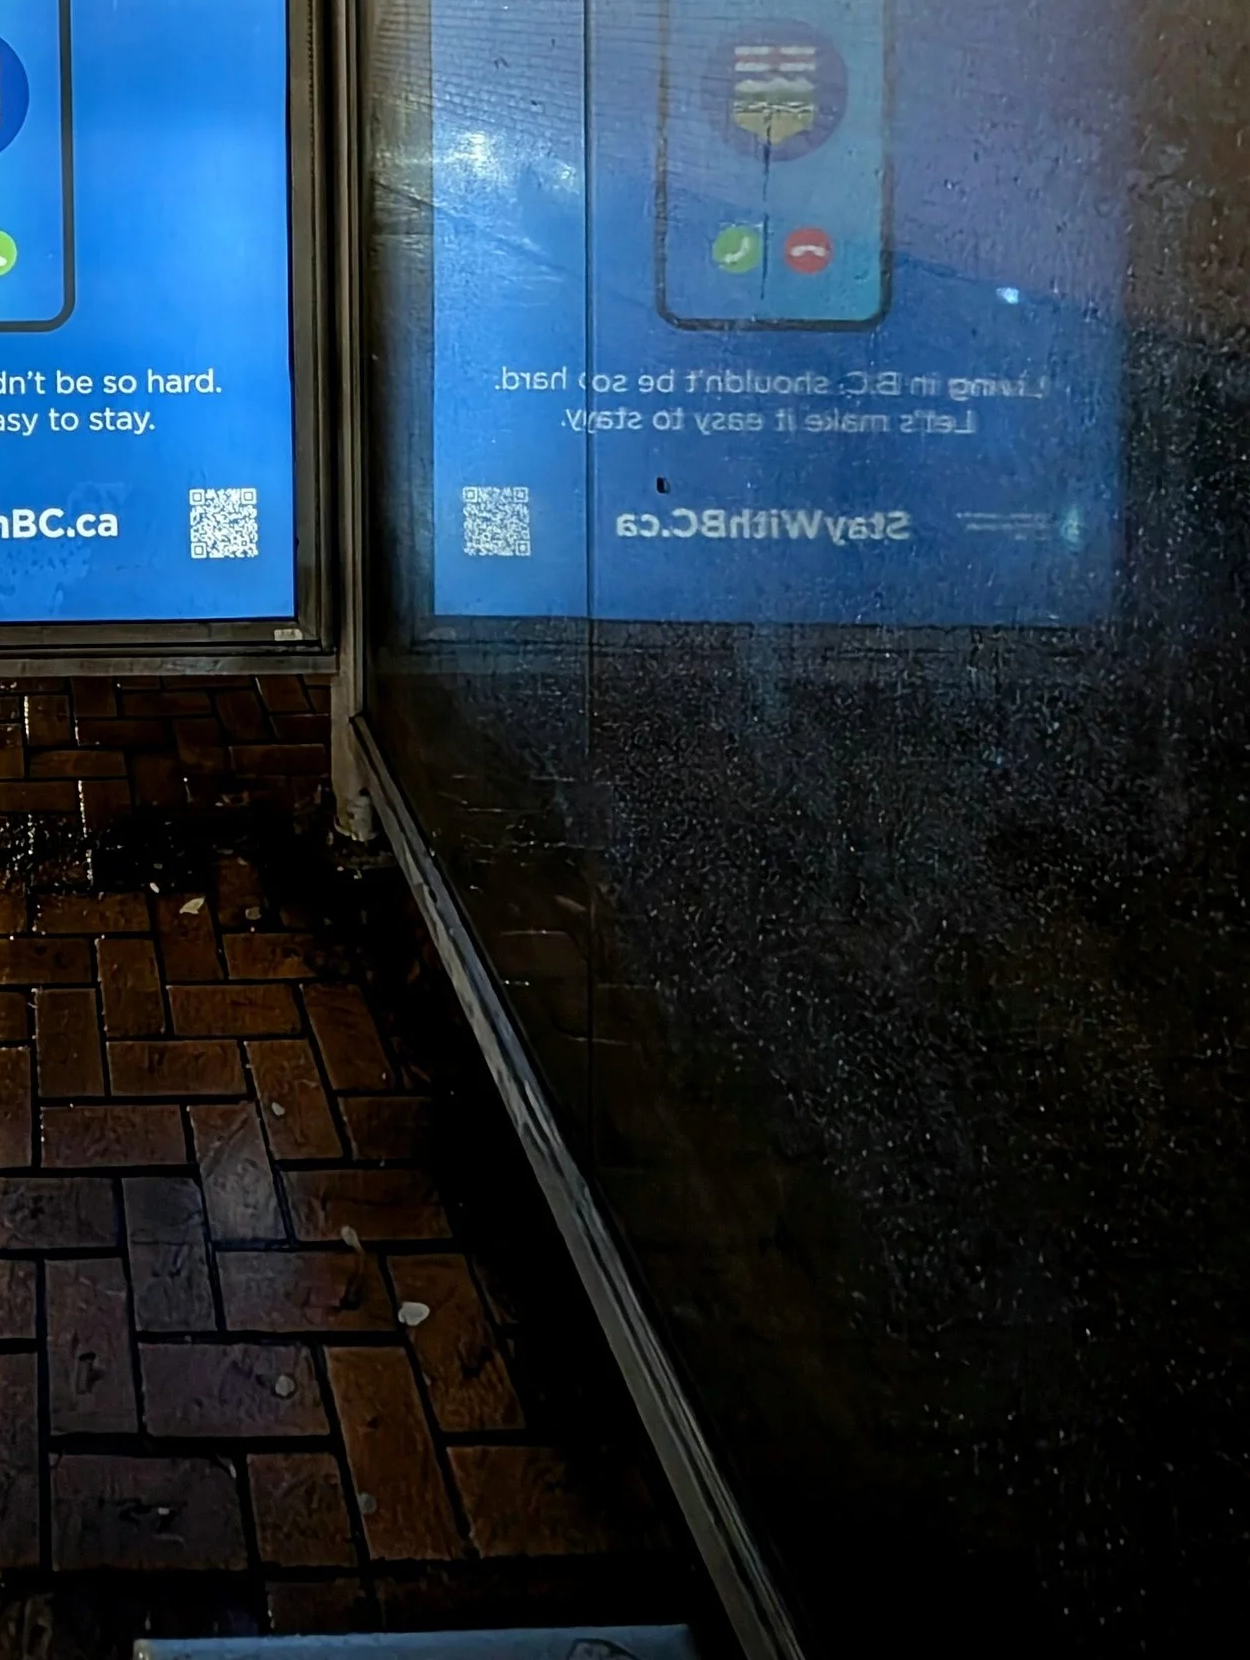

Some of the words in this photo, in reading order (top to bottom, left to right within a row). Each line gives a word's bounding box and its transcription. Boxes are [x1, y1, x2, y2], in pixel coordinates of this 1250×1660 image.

[56, 369, 93, 394] be
[103, 374, 137, 394] so
[147, 367, 223, 393] hard.
[48, 407, 80, 431] to
[88, 406, 156, 435] stay.
